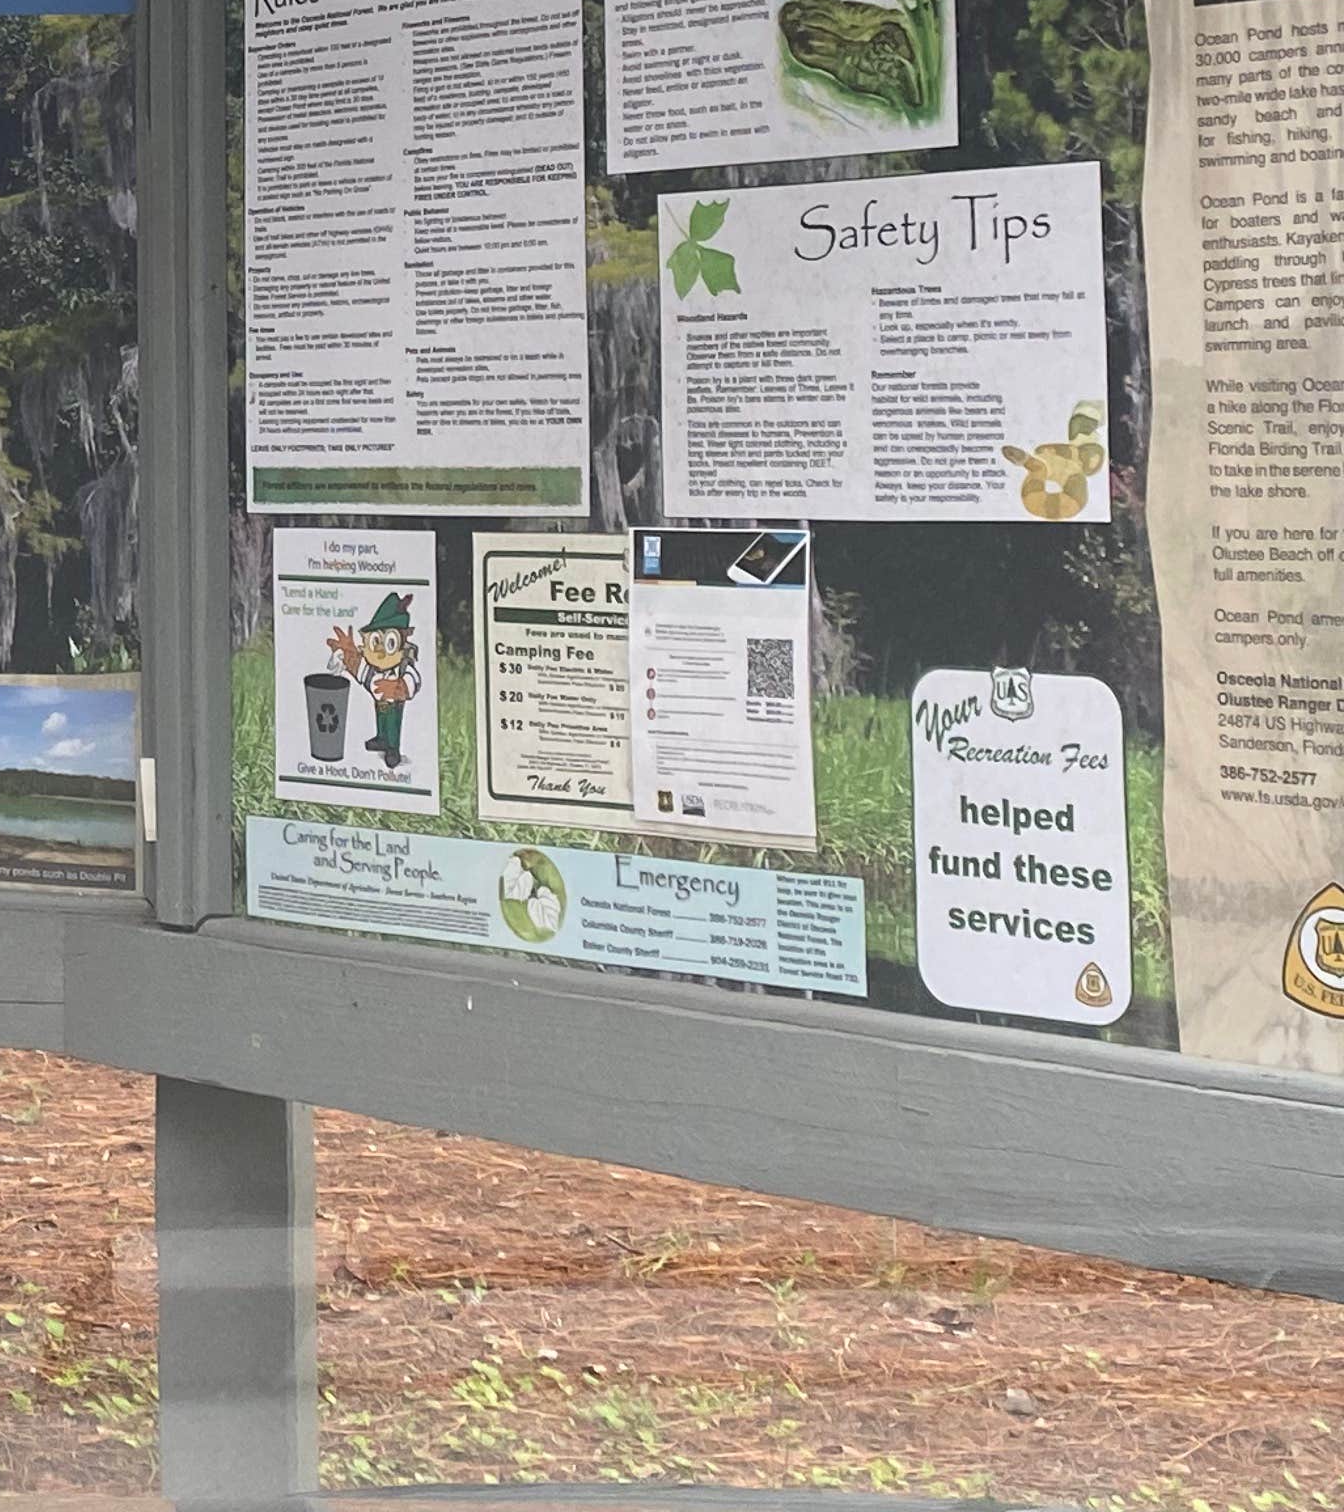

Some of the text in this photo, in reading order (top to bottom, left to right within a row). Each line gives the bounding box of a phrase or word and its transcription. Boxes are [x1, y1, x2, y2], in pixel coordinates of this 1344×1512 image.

[1195, 23, 1328, 47] Ocean Pond hosts
[1249, 46, 1308, 64] campers
[1196, 65, 1320, 87] many parts of the
[1196, 86, 1317, 107] two-mile wide lake
[1198, 104, 1343, 129] sandy beach and
[1198, 134, 1215, 148] for
[1199, 150, 1296, 168] swimming and
[1200, 191, 1324, 209] Ocean Pond is a
[794, 193, 1051, 265] Safety Tips
[1202, 211, 1319, 230] for boaters and
[1203, 252, 1327, 273] paddling through
[1204, 273, 1327, 294] Cypress trees that
[1204, 296, 1301, 313] Campers can
[1205, 339, 1272, 354] swimming
[329, 541, 340, 553] do
[1212, 545, 1335, 562] Olustee Beach off
[488, 546, 567, 602] Welcome!
[551, 581, 596, 603] Fee
[1214, 608, 1304, 627] Ocean Pond
[1215, 631, 1274, 647] campers
[495, 642, 595, 662] Camping Fee
[1216, 671, 1343, 691] Osceola National
[1217, 692, 1331, 714] Olustee Ranger
[916, 695, 982, 752] Your
[1217, 713, 1286, 732] 24874 US
[947, 736, 1109, 774] Recreation Fees
[527, 775, 606, 797] Thank You
[1220, 764, 1317, 787] 386-752-2577
[960, 795, 1075, 836] helped
[283, 823, 411, 856] Caring for the Land
[313, 850, 444, 888] and Serving People.
[929, 845, 1113, 892] fund these
[615, 855, 741, 907] Emergency
[948, 907, 1097, 946] services
